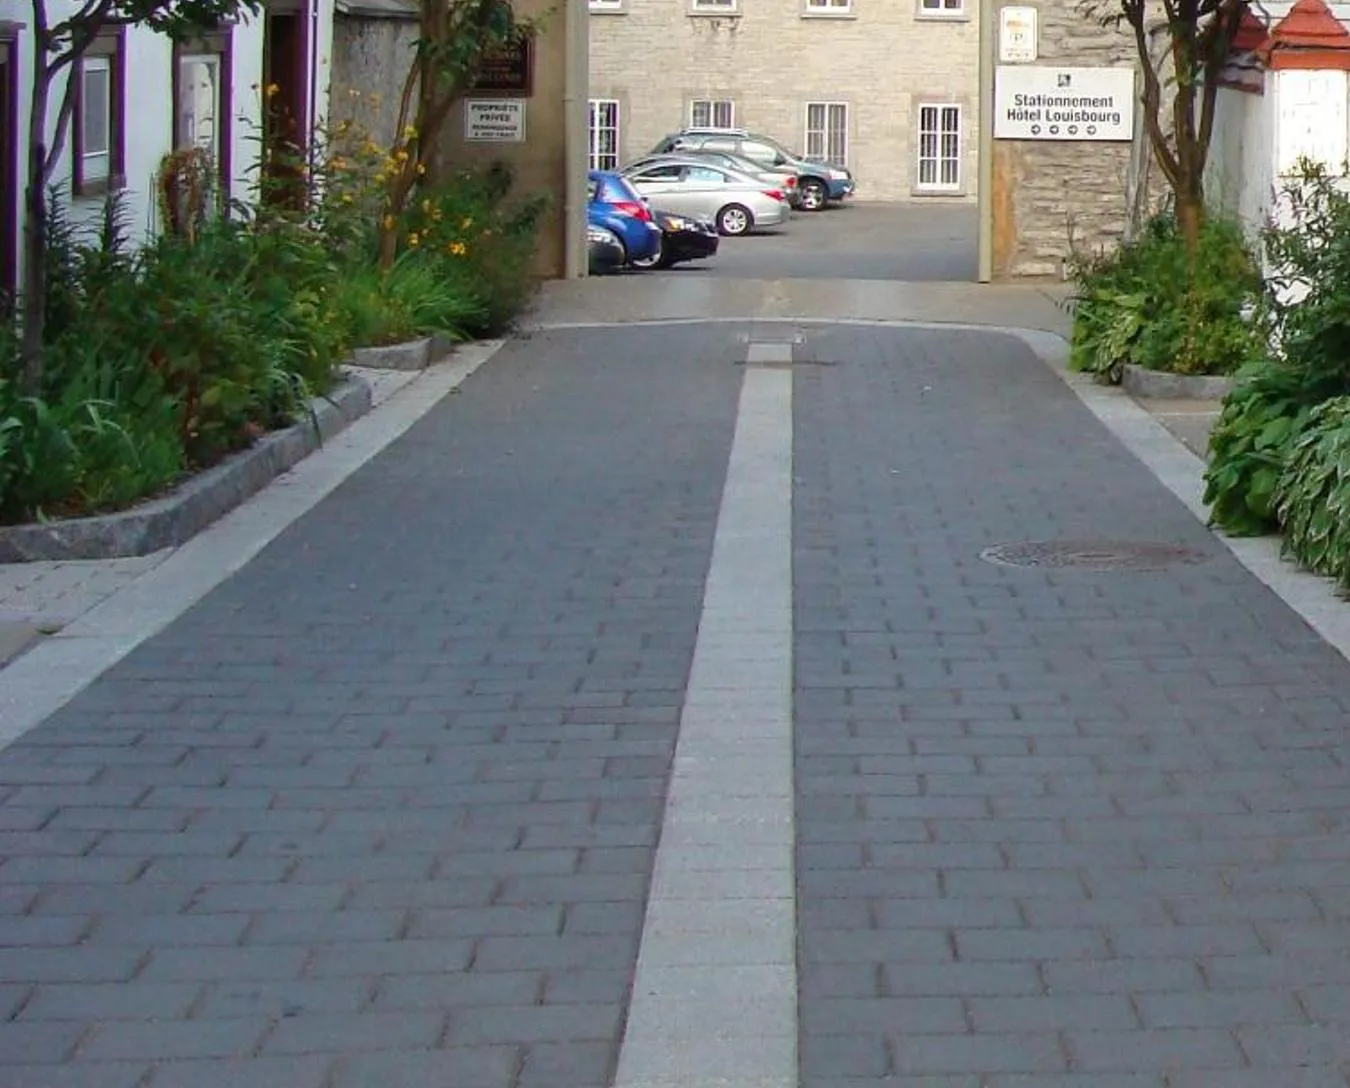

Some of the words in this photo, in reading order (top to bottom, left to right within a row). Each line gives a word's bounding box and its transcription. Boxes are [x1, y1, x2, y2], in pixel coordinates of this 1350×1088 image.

[1014, 93, 1114, 108] Stationnement
[1007, 107, 1041, 121] Hôtel
[1045, 109, 1121, 125] Louisbourg
